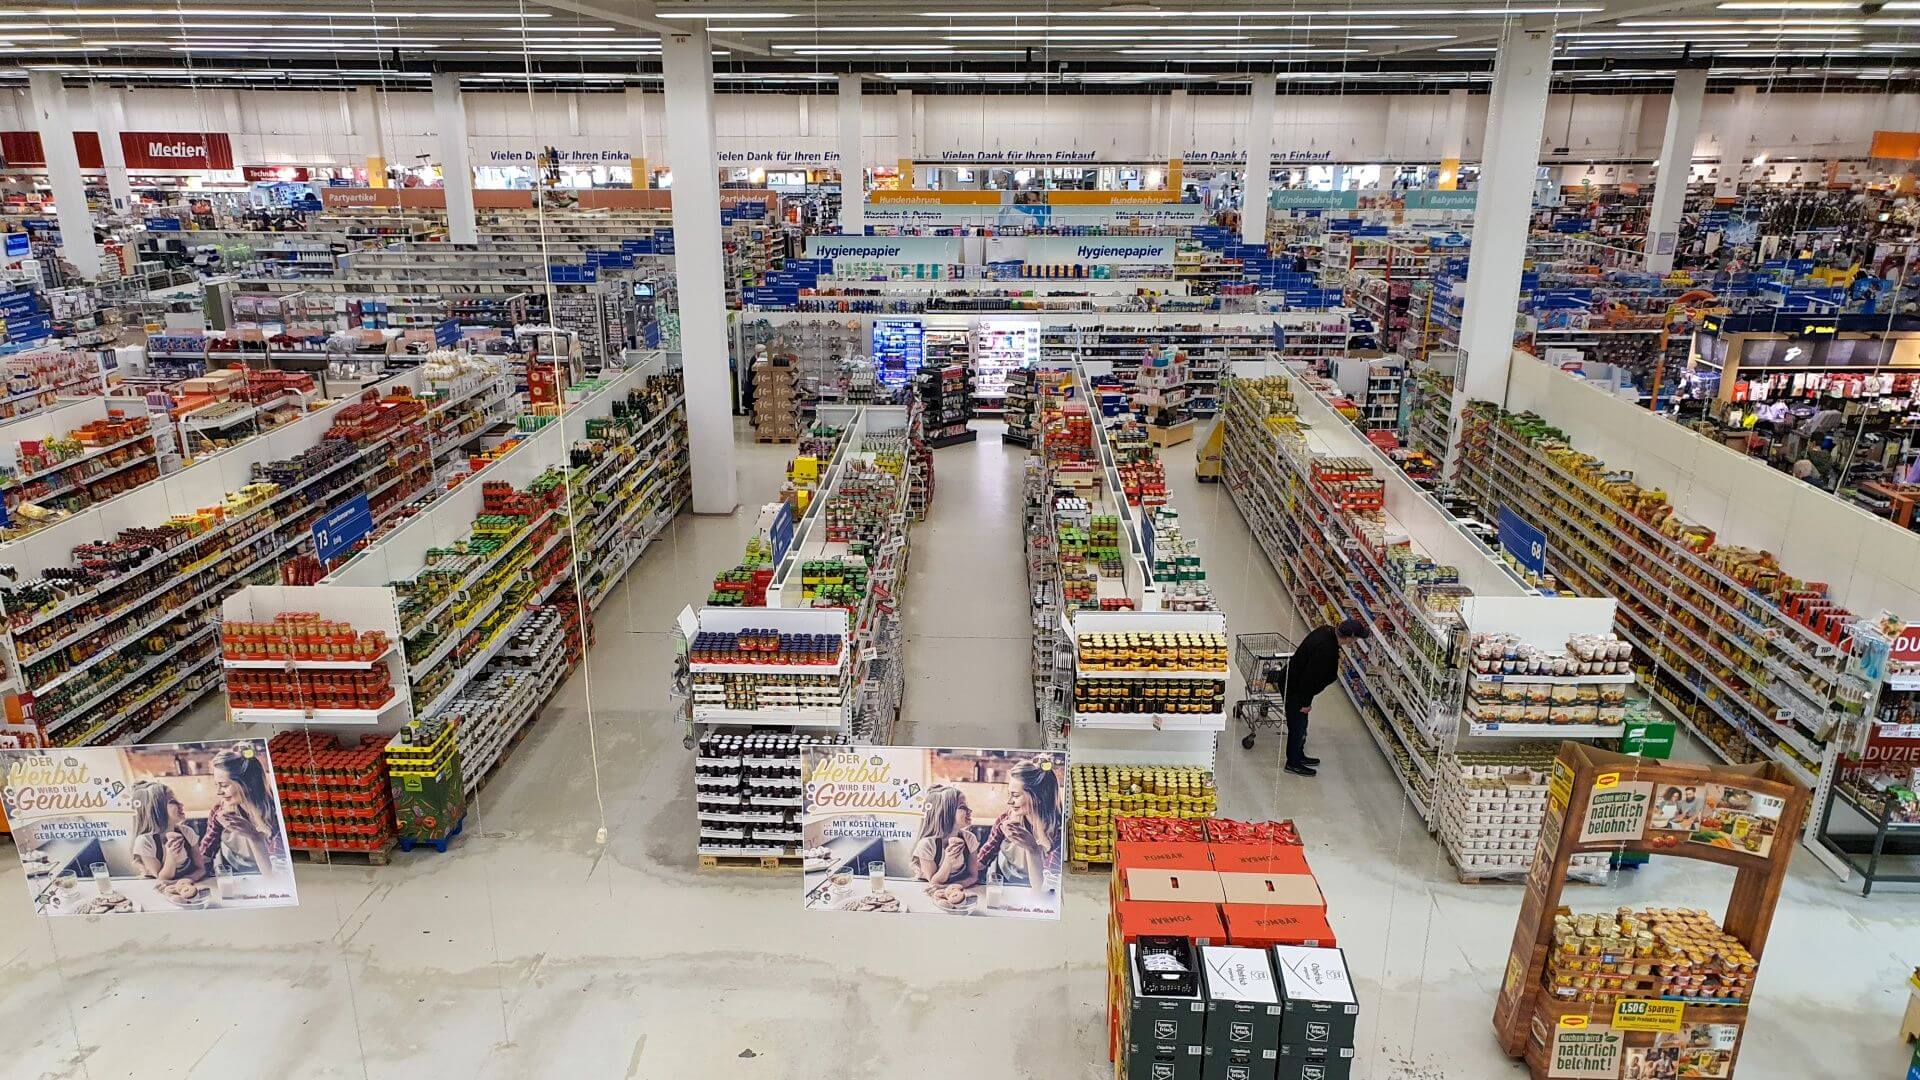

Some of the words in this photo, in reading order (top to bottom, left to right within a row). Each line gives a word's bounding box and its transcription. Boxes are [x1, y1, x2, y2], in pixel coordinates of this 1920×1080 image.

[149, 142, 206, 158] Medien
[490, 150, 522, 161] Vielen
[572, 150, 598, 161] Ihren
[602, 150, 631, 161] Einka
[942, 150, 974, 160] Vielen
[977, 150, 1003, 160] Dank
[1007, 150, 1023, 160] für
[1026, 150, 1052, 160] Ihren
[1055, 150, 1096, 160] Einkauf
[1183, 150, 1208, 160] ielen
[1211, 150, 1237, 160] Dank
[1289, 150, 1331, 160] Einkauf
[717, 151, 744, 162] ielen
[747, 151, 773, 161] Dank
[776, 151, 792, 161] für
[794, 151, 820, 161] Ihren
[329, 192, 377, 204] Partyartikel
[879, 195, 941, 204] Hundenahrung
[1279, 195, 1343, 205] Kindernahrung
[816, 245, 901, 259] Hygienepapier
[1077, 245, 1163, 259] Hygienepapier
[317, 529, 328, 549] 73
[1531, 541, 1542, 560] 68
[29, 757, 54, 767] DER
[837, 754, 860, 764] DER
[8, 759, 90, 786] Herbst
[812, 758, 892, 783] Herbst
[37, 786, 60, 794] WIRD
[815, 783, 901, 808] Genuss
[16, 786, 108, 811] Genuss
[1590, 803, 1643, 820] natürlich
[41, 823, 56, 831] MIT
[59, 821, 108, 830] KÖSTLICHEN
[832, 820, 847, 828] MIT
[849, 820, 895, 828] KÖSTLICHEN
[1588, 819, 1638, 835] belohnt!
[34, 829, 127, 840] GEBÄCK-SPEZIALITÄTEN
[823, 829, 912, 838] GEBÄCK-SPEZIALITÄTEN
[1143, 853, 1184, 861] POMBAR
[1238, 855, 1280, 863] POMBAR
[1149, 915, 1192, 924] POMBAR
[1256, 917, 1300, 926] POMBAR
[1621, 1002, 1646, 1013] 1,50€
[1648, 1005, 1675, 1014] sparen
[1558, 1043, 1617, 1057] natürlich
[1557, 1057, 1612, 1071] belohnt!
